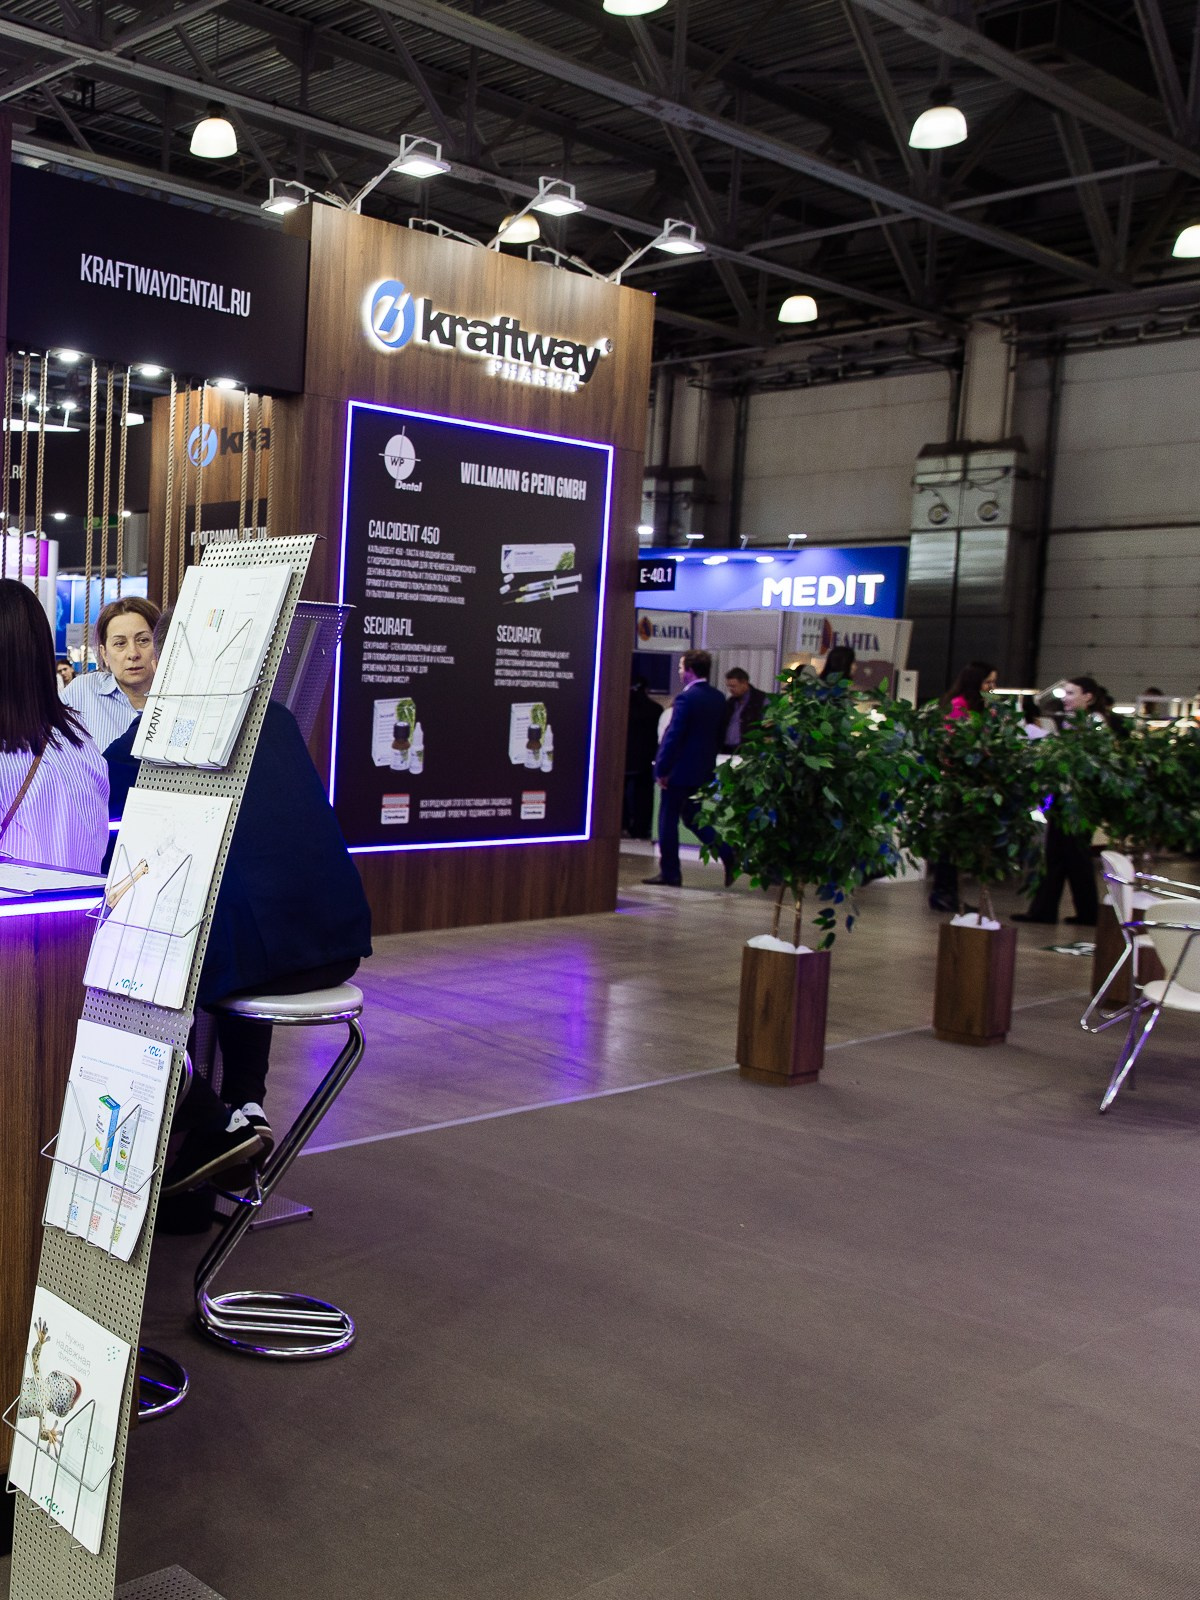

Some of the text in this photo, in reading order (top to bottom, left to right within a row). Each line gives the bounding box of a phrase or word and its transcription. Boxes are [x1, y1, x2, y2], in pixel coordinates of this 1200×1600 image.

[80, 253, 251, 317] KRAFTWAYDENTAL.RU
[421, 297, 601, 384] kraftway
[492, 360, 578, 392] PHARMA
[394, 479, 423, 492] Dental
[460, 462, 587, 501] WILLMANN & PEIN GMBH
[190, 528, 238, 546] ПОГРАММА
[368, 519, 440, 545] CALCIDENT 450
[640, 567, 672, 583] E-40.1
[761, 573, 885, 607] MEDIT
[363, 615, 414, 637] SECURAFIL
[496, 624, 542, 644] SECURAFIX
[145, 706, 163, 743] MANI
[55, 1338, 92, 1369] надежная
[65, 1330, 86, 1351] Нужна
